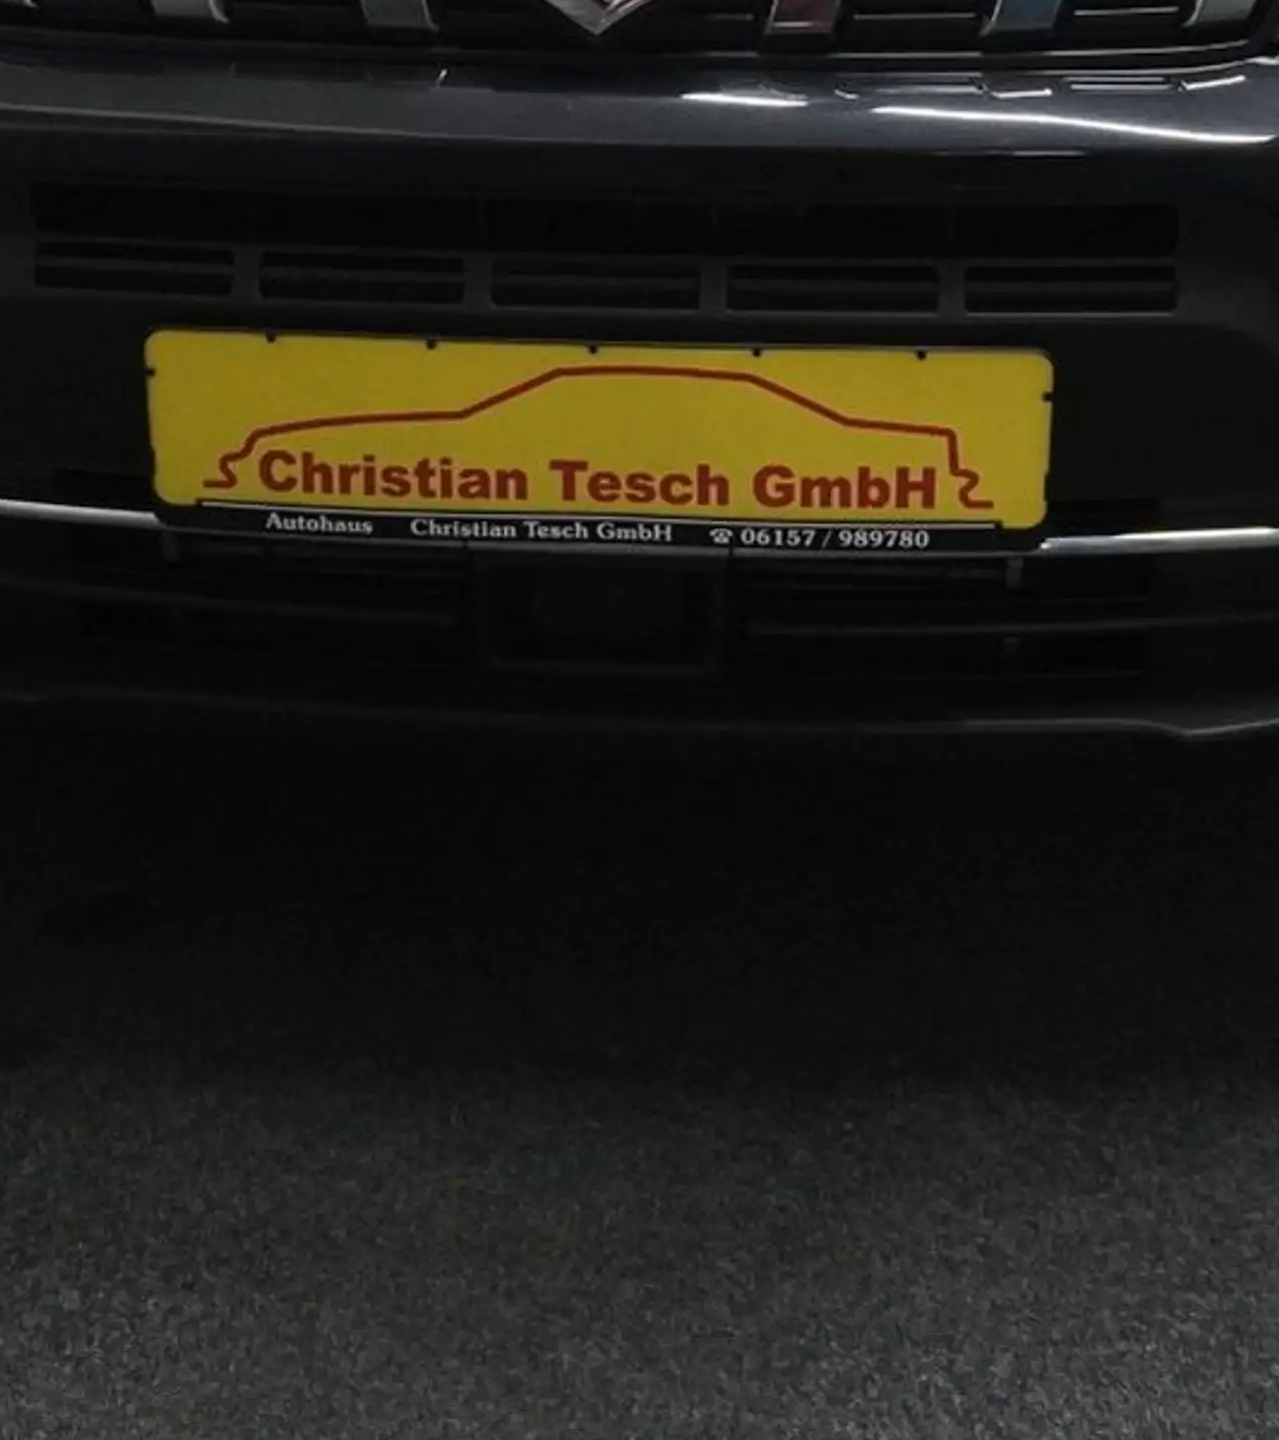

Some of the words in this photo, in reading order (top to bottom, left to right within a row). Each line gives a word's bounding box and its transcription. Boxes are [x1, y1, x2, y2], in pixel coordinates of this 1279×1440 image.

[258, 449, 529, 501] Christian
[550, 460, 730, 505] Tesch
[753, 465, 936, 509] GmbH
[265, 511, 373, 535] Autohaus
[410, 518, 517, 539] Christian
[525, 520, 589, 541] Tesch
[597, 521, 673, 543] GmbH
[740, 526, 815, 549] 06157
[838, 528, 931, 550] 989780
